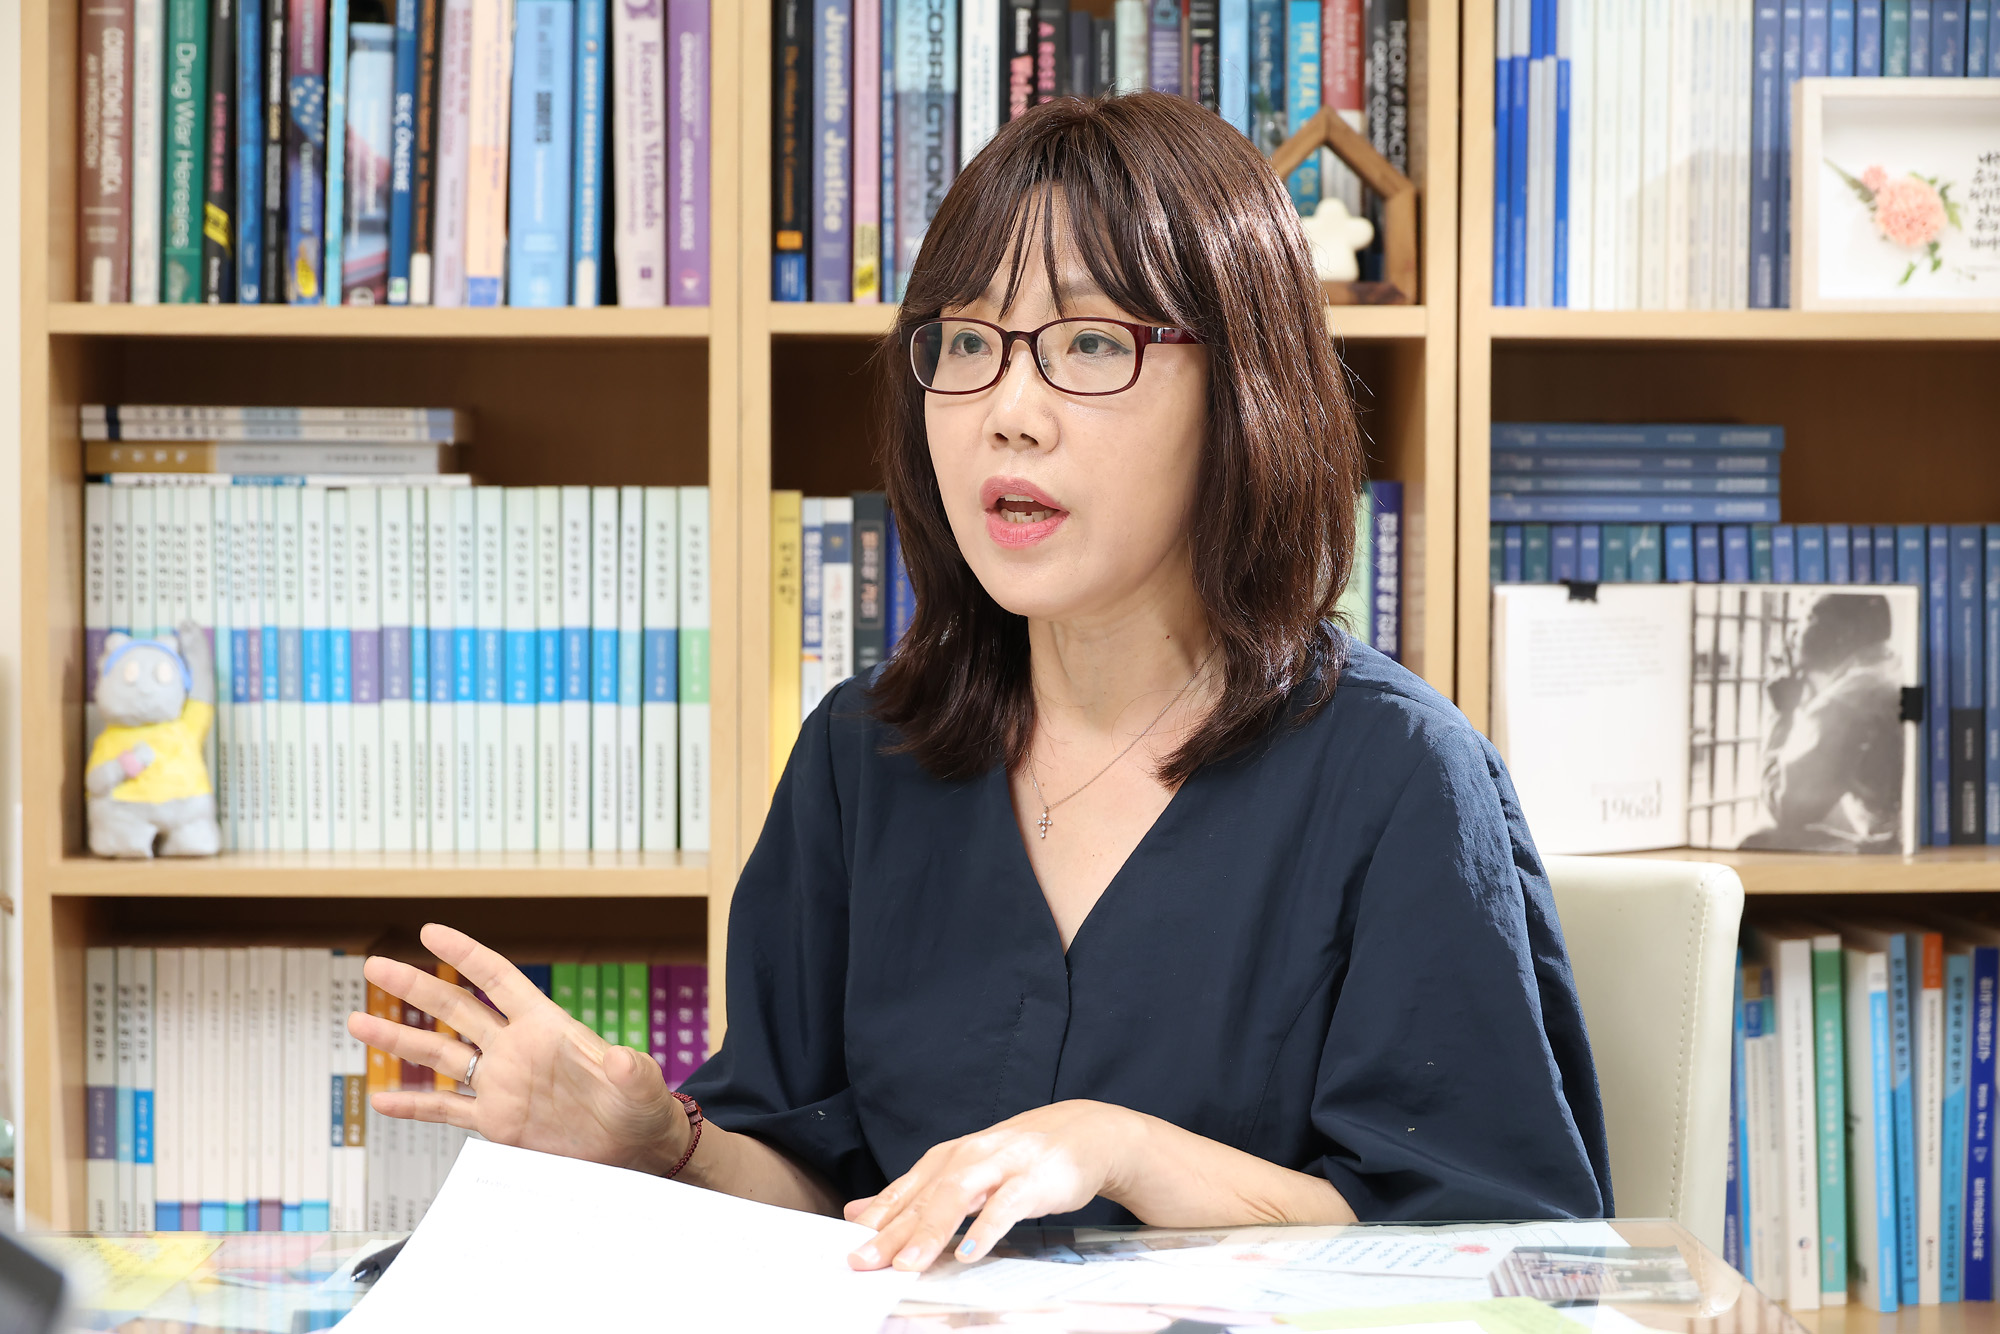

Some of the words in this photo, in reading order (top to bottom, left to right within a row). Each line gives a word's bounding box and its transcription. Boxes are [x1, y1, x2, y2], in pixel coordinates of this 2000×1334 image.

[171, 42, 197, 99] Drug
[823, 5, 848, 122] Juvenile
[1299, 21, 1315, 55] THE
[1372, 40, 1387, 94] GROUP
[1389, 20, 1406, 85] THEORY
[640, 40, 659, 134] Research
[1299, 62, 1316, 110] REAL
[175, 101, 195, 147] War
[172, 150, 194, 248] Heresies
[641, 141, 662, 229] Methods
[823, 129, 848, 233] Justice
